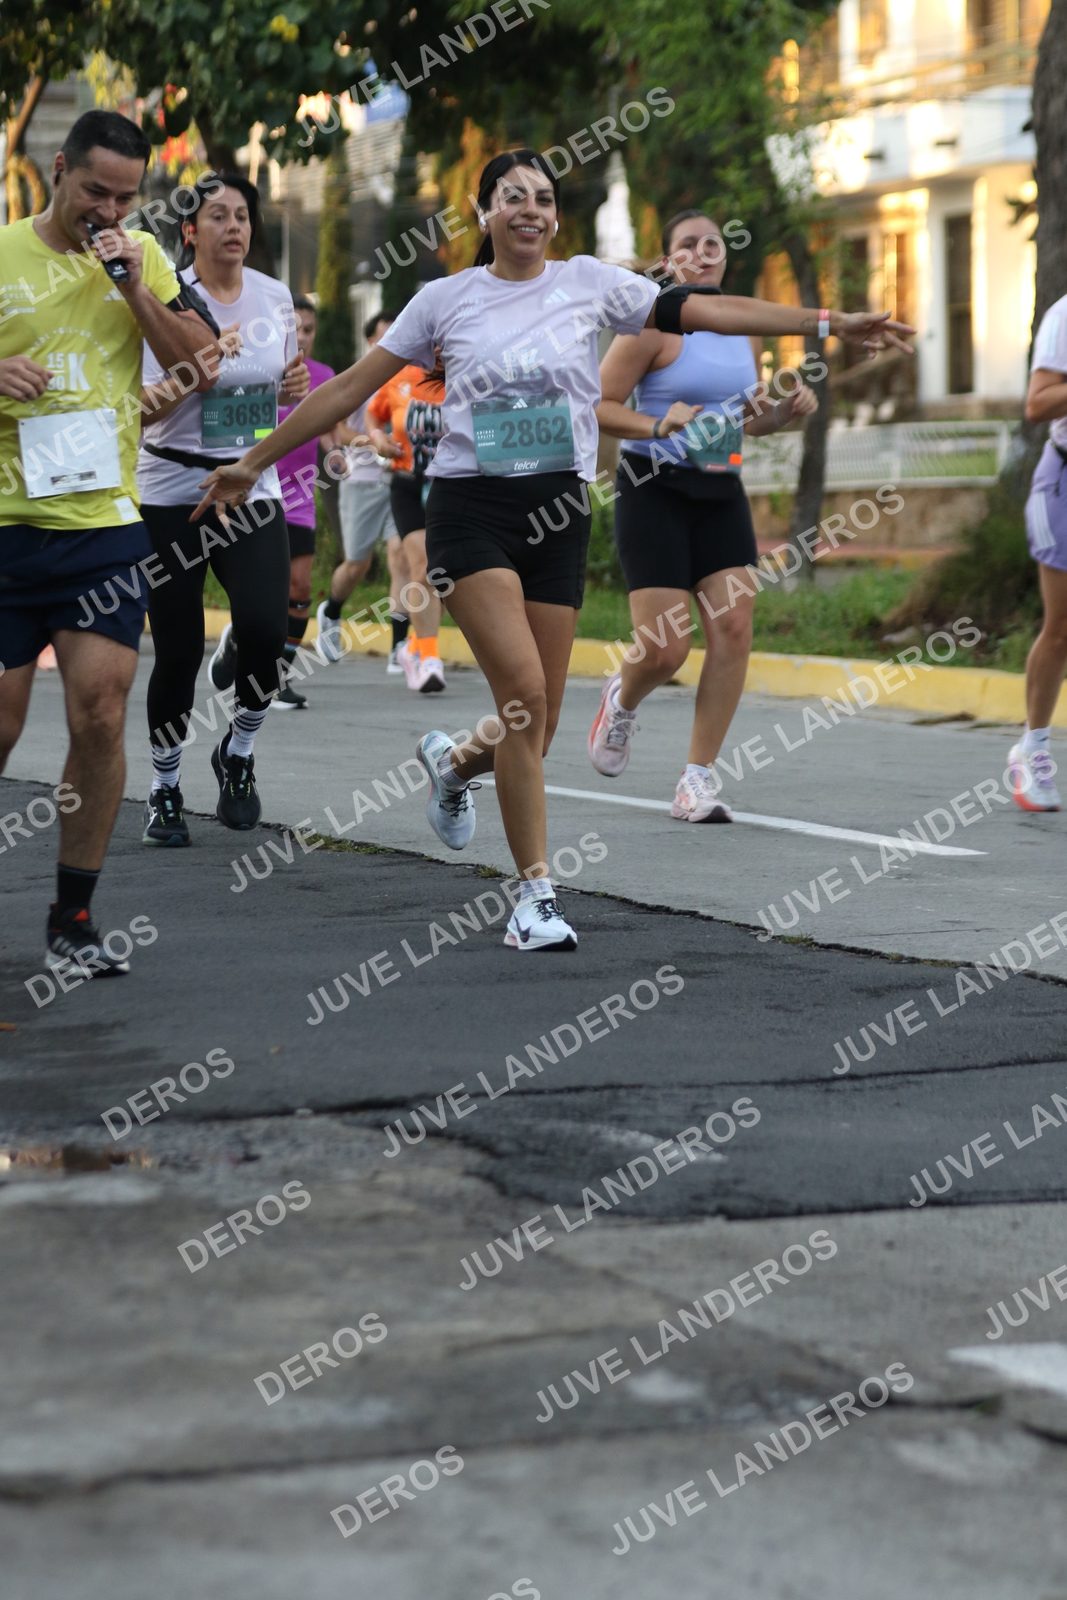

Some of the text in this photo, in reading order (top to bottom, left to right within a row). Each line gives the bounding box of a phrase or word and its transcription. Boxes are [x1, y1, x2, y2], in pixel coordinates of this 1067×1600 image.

[48, 352, 64, 368] 15
[68, 352, 91, 391] K
[223, 401, 273, 427] 3689
[499, 415, 569, 449] 2862
[513, 459, 540, 471] telcel
